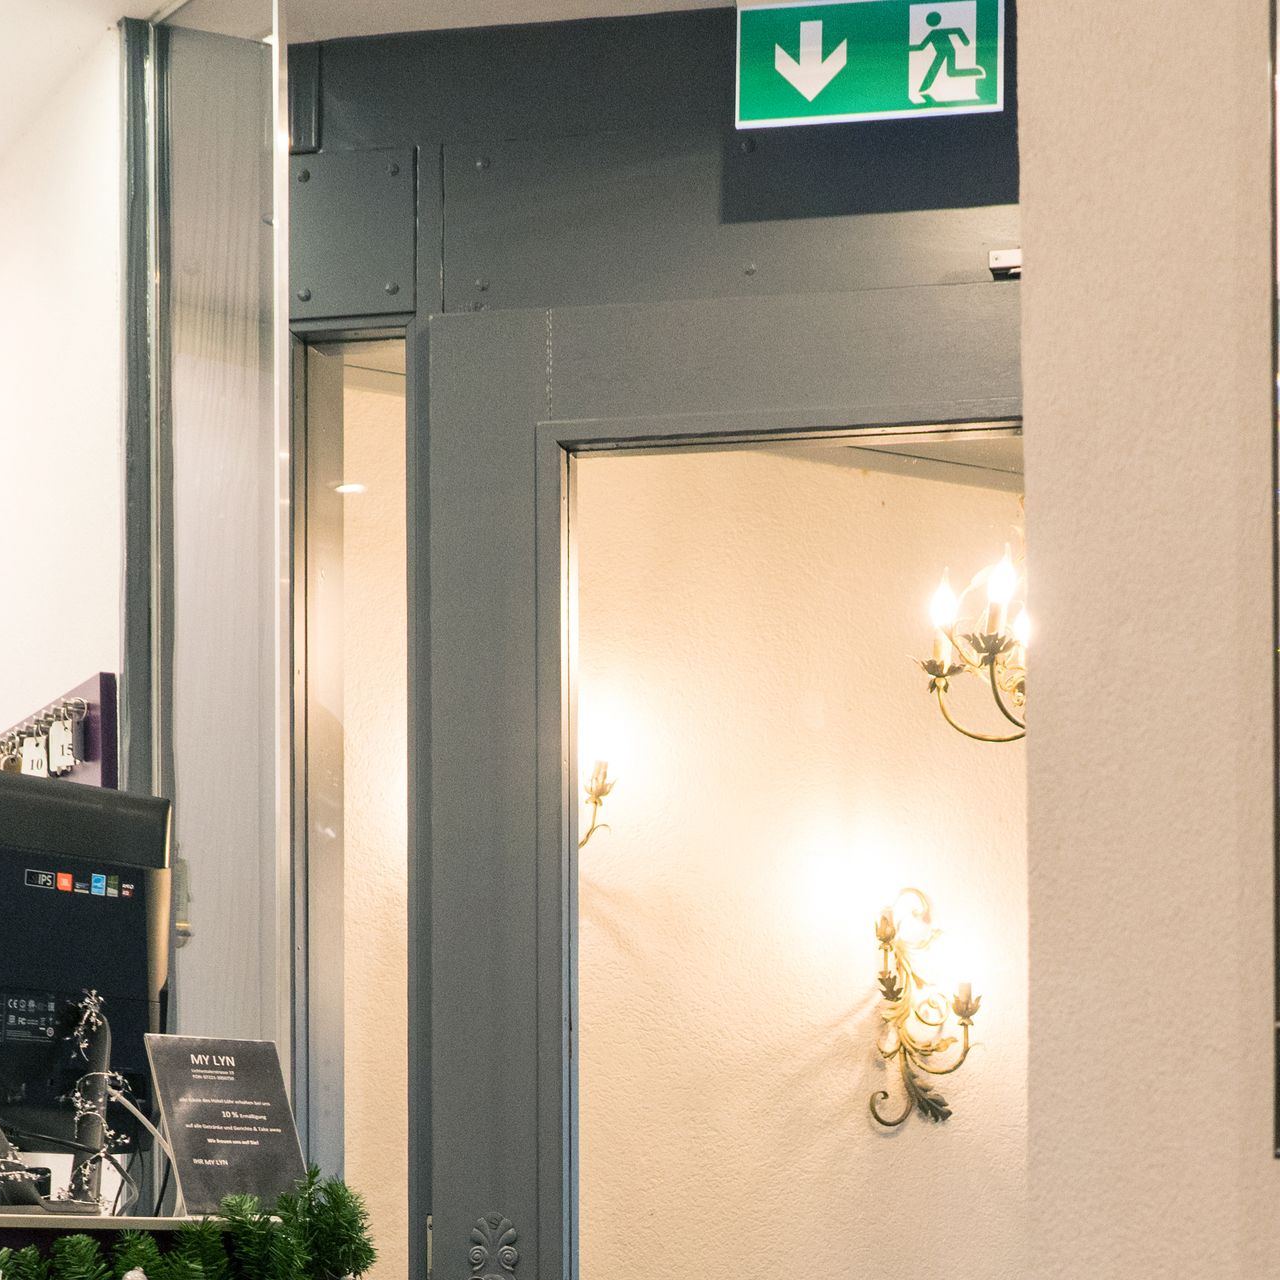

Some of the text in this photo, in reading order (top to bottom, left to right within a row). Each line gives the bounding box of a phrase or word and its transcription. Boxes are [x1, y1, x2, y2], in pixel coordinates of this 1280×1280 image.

[30, 759, 43, 770] 10
[38, 874, 52, 886] IPS
[190, 1053, 236, 1067] MY LYN
[221, 1110, 231, 1118] 10
